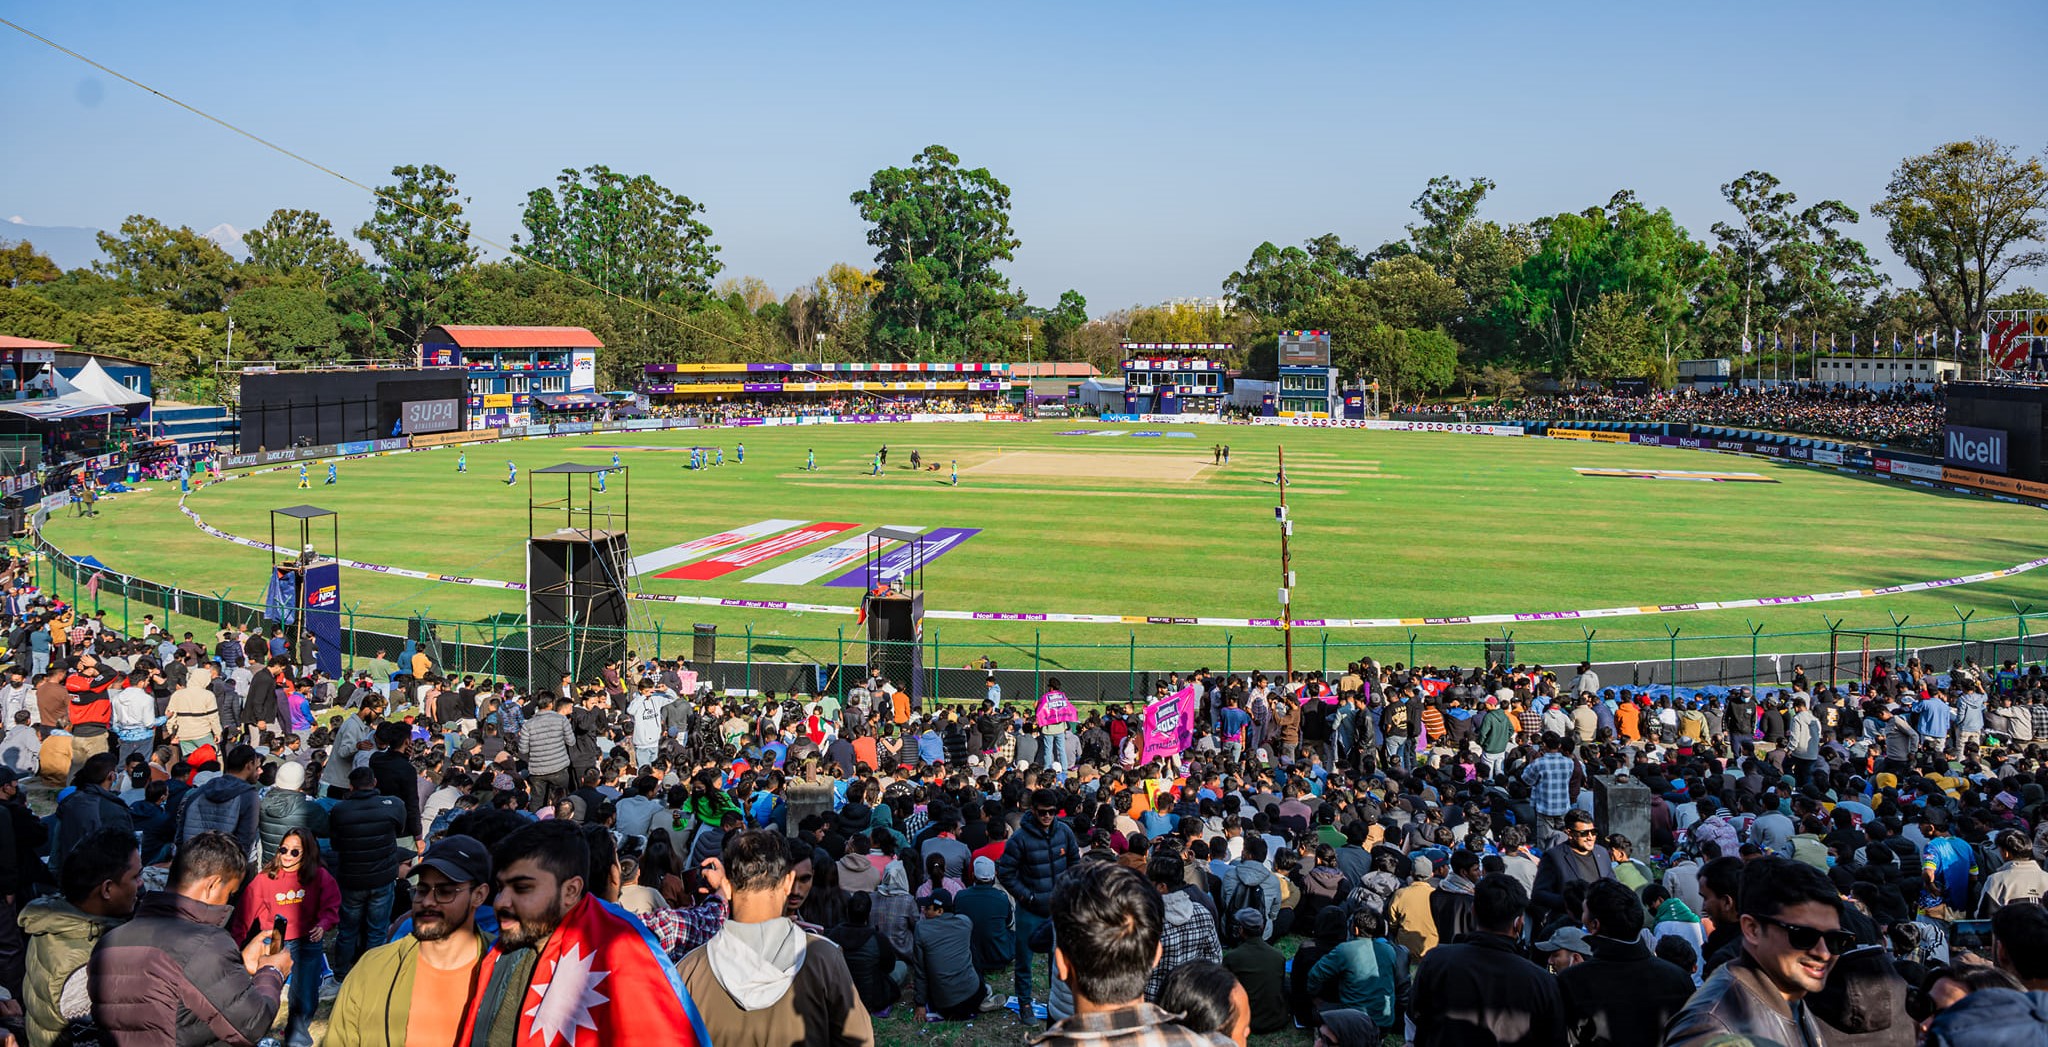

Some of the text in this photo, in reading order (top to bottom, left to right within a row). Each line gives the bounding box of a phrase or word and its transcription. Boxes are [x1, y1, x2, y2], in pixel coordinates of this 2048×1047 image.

[410, 402, 452, 421] SUPA
[488, 418, 506, 426] Ncell
[669, 417, 690, 427] Ncell
[381, 440, 401, 450] Ncell
[1639, 434, 1660, 445] Ncell
[1679, 437, 1700, 448] Ncell
[1789, 447, 1808, 459] Ncell
[1949, 430, 2001, 466] Ncell
[319, 590, 337, 602] NPL
[2001, 678, 2013, 690] 18
